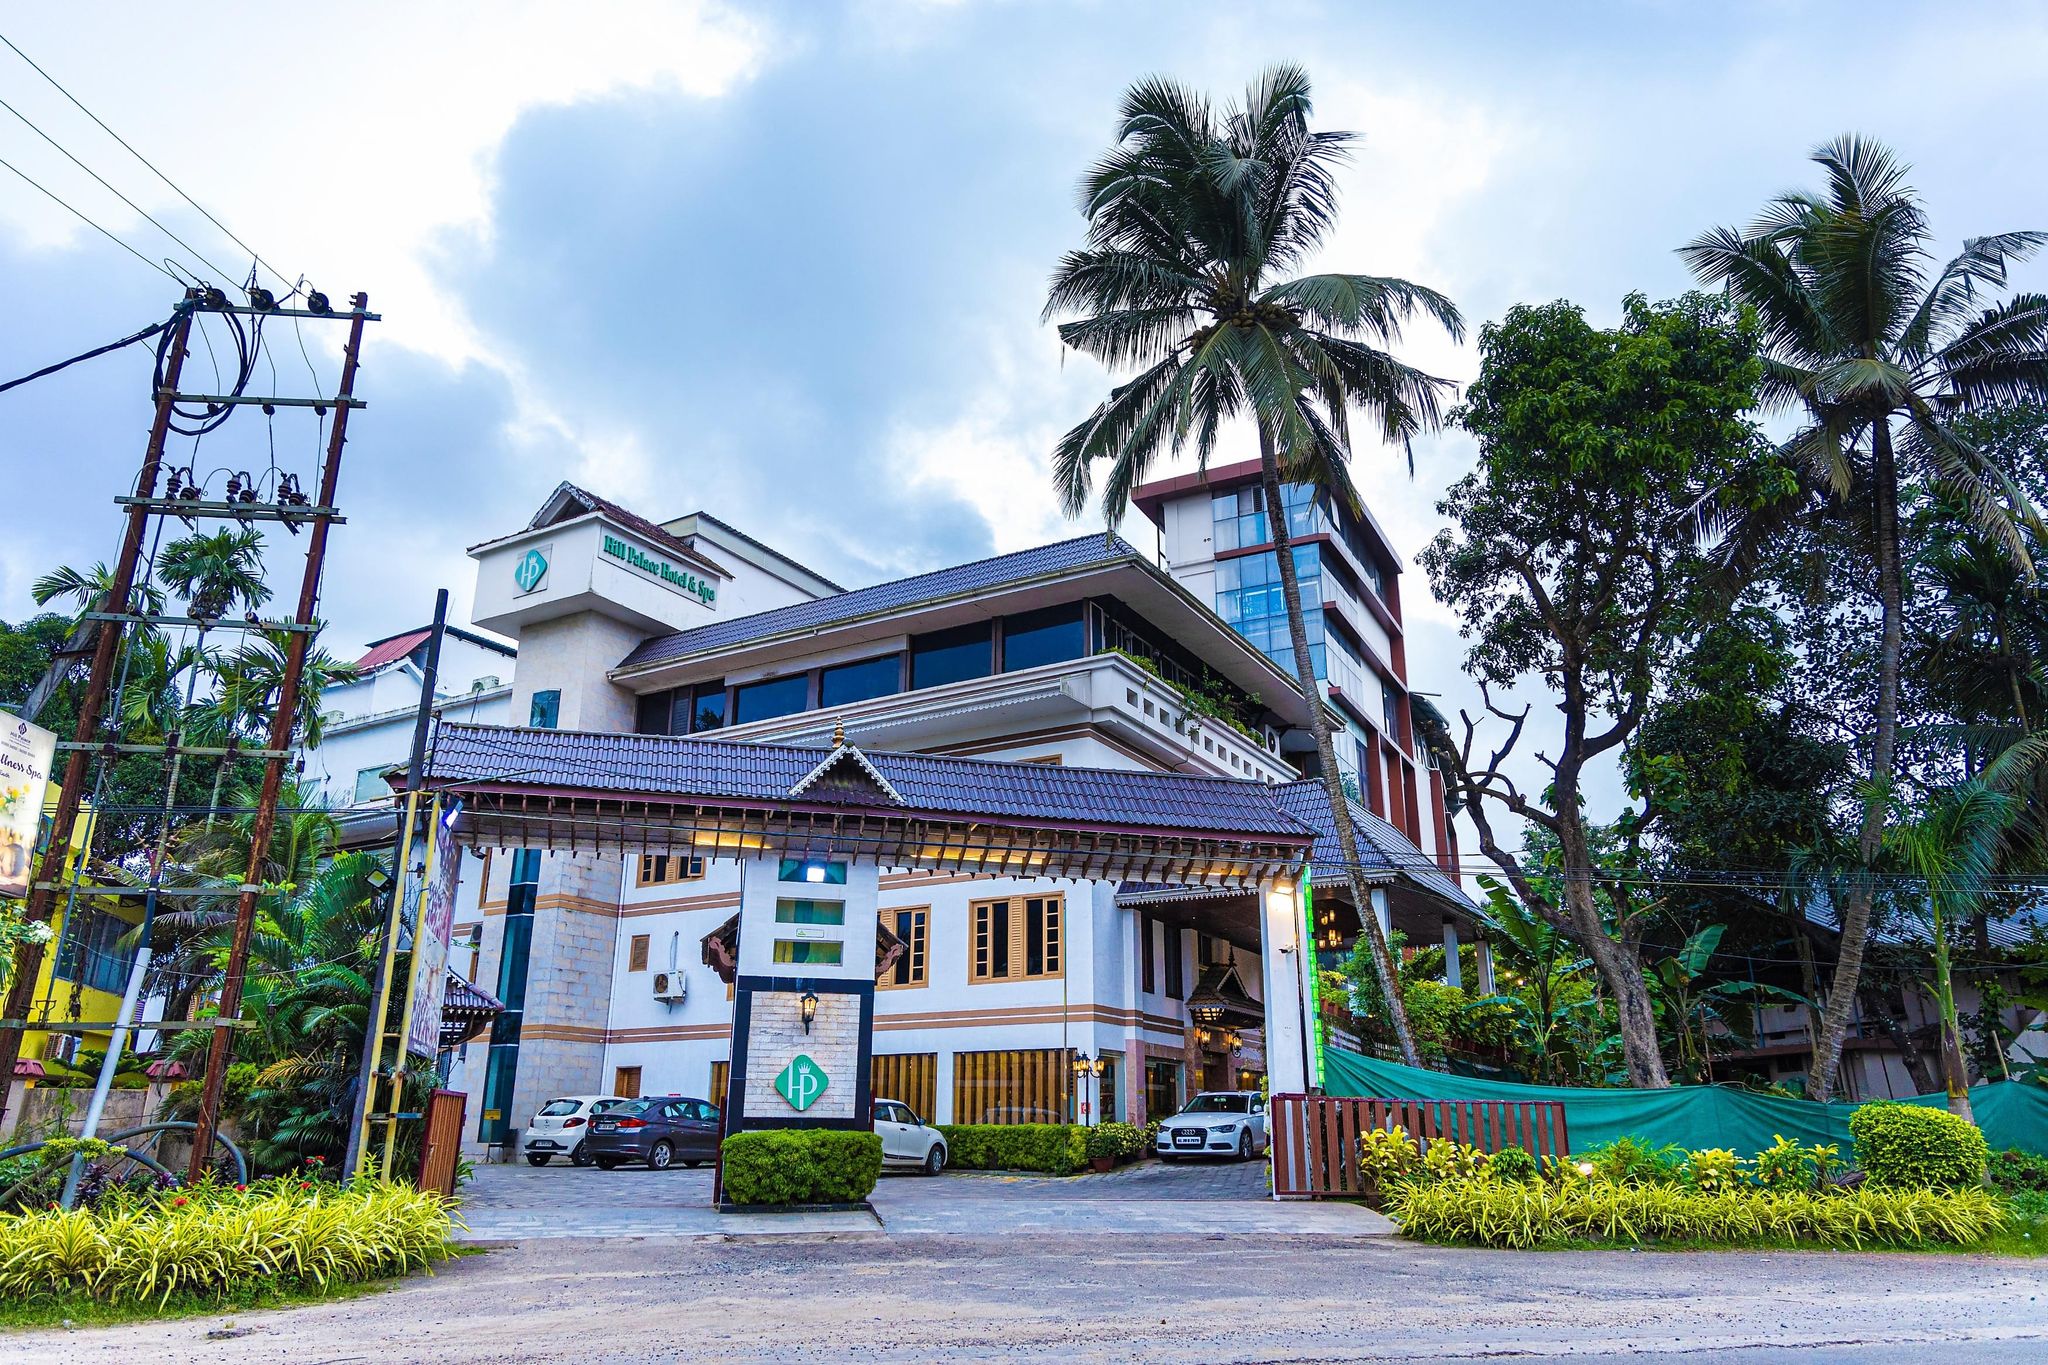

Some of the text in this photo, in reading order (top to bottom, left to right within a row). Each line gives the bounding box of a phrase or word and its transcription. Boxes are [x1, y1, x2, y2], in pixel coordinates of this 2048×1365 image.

[604, 535, 715, 603] Hill Palace Hotel & Spa
[26, 764, 42, 780] Spa
